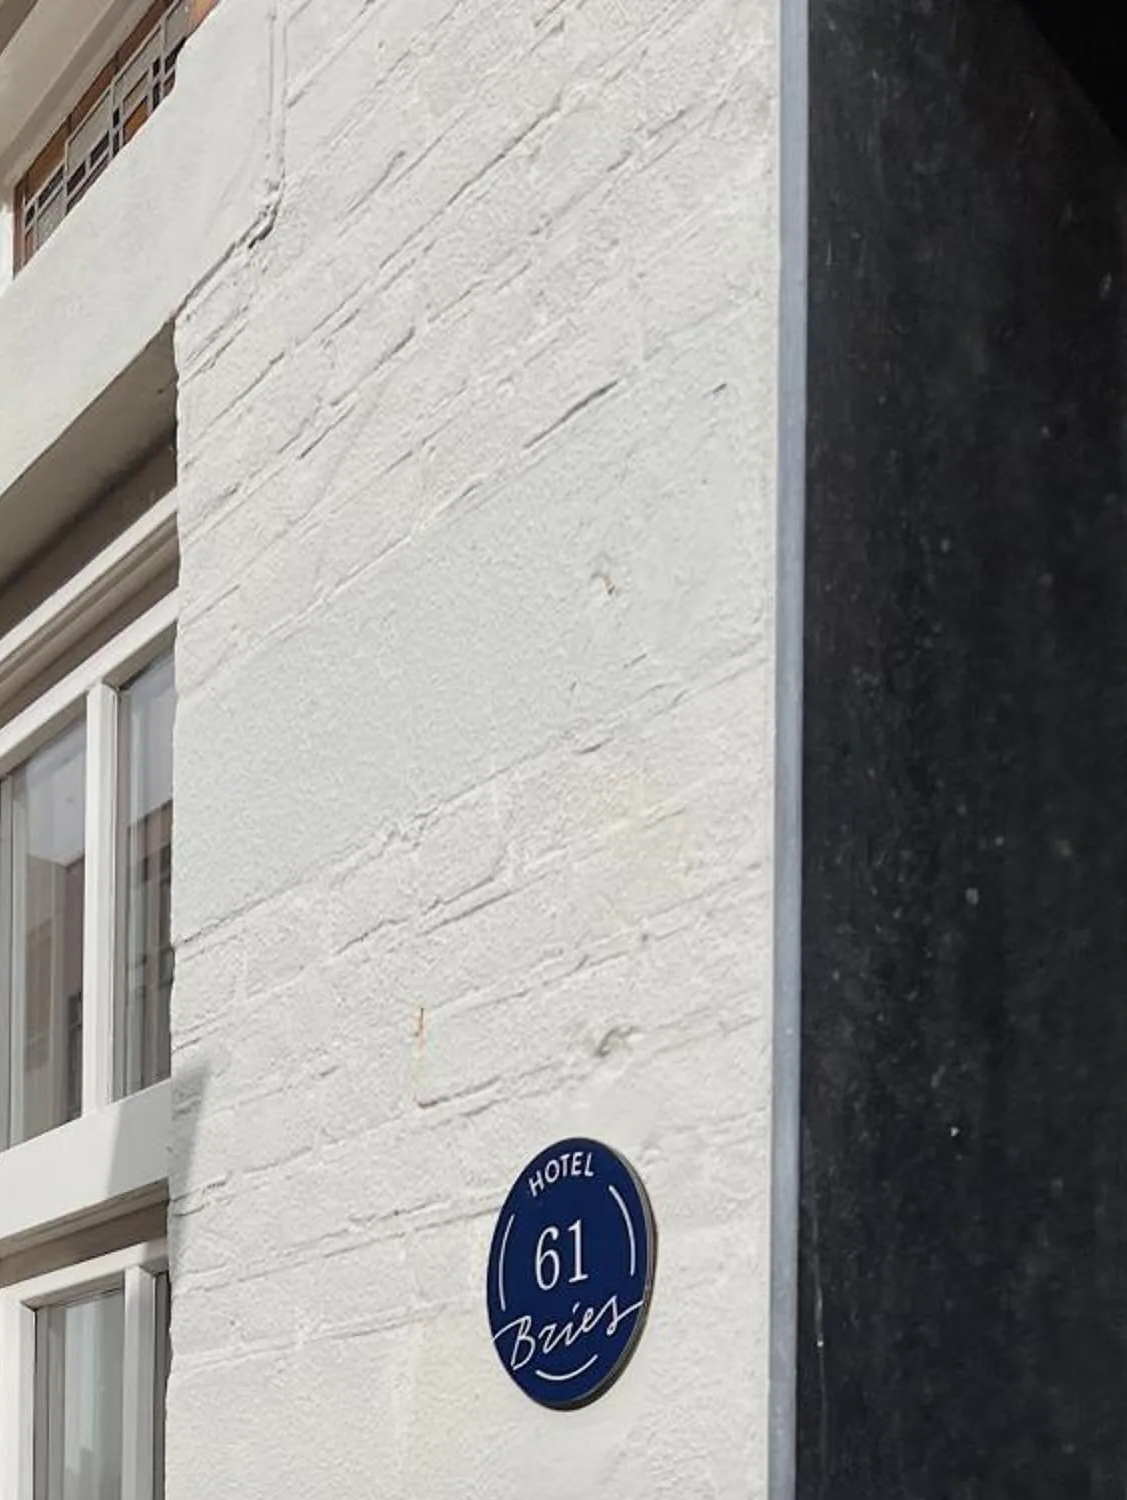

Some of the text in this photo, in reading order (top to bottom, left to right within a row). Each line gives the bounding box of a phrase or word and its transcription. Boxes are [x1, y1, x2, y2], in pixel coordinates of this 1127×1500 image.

[527, 1151, 595, 1198] HOTEL
[534, 1218, 589, 1291] 61
[491, 1294, 645, 1371] Bries
